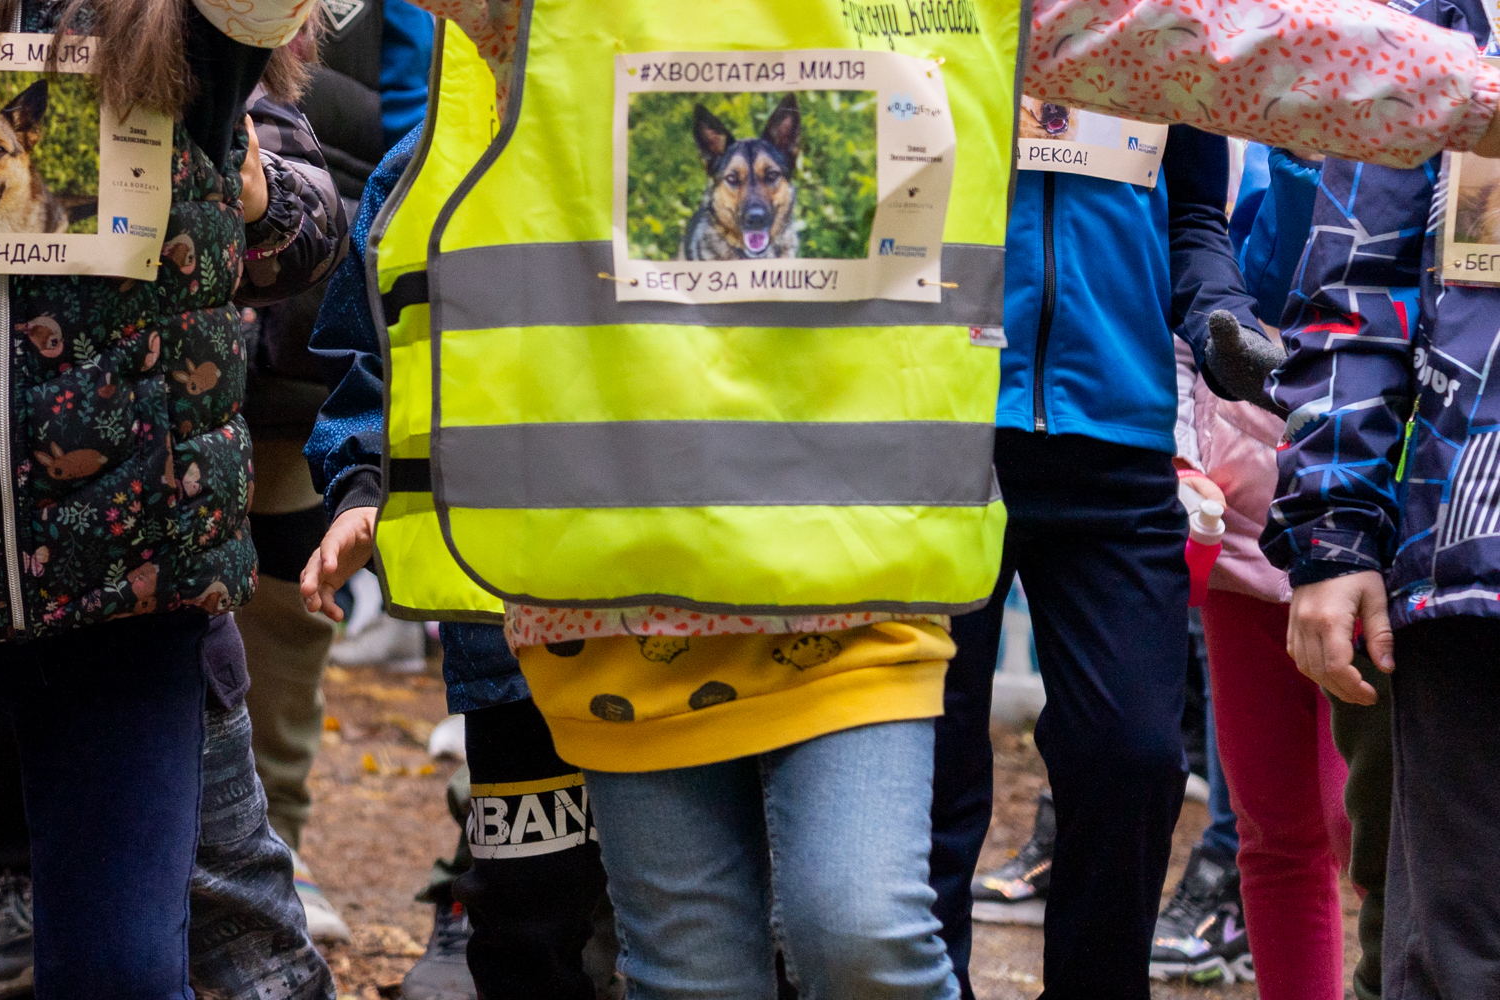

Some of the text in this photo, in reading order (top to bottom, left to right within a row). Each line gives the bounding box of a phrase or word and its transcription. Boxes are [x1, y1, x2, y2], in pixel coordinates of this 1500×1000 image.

[639, 60, 866, 85] #ХВОСТАТАЯ_МИЛЯ
[1029, 146, 1089, 166] РЕКСА!
[1465, 253, 1500, 272] БЕГ
[646, 269, 839, 292] БЕГУ ЗА МИШКУ!
